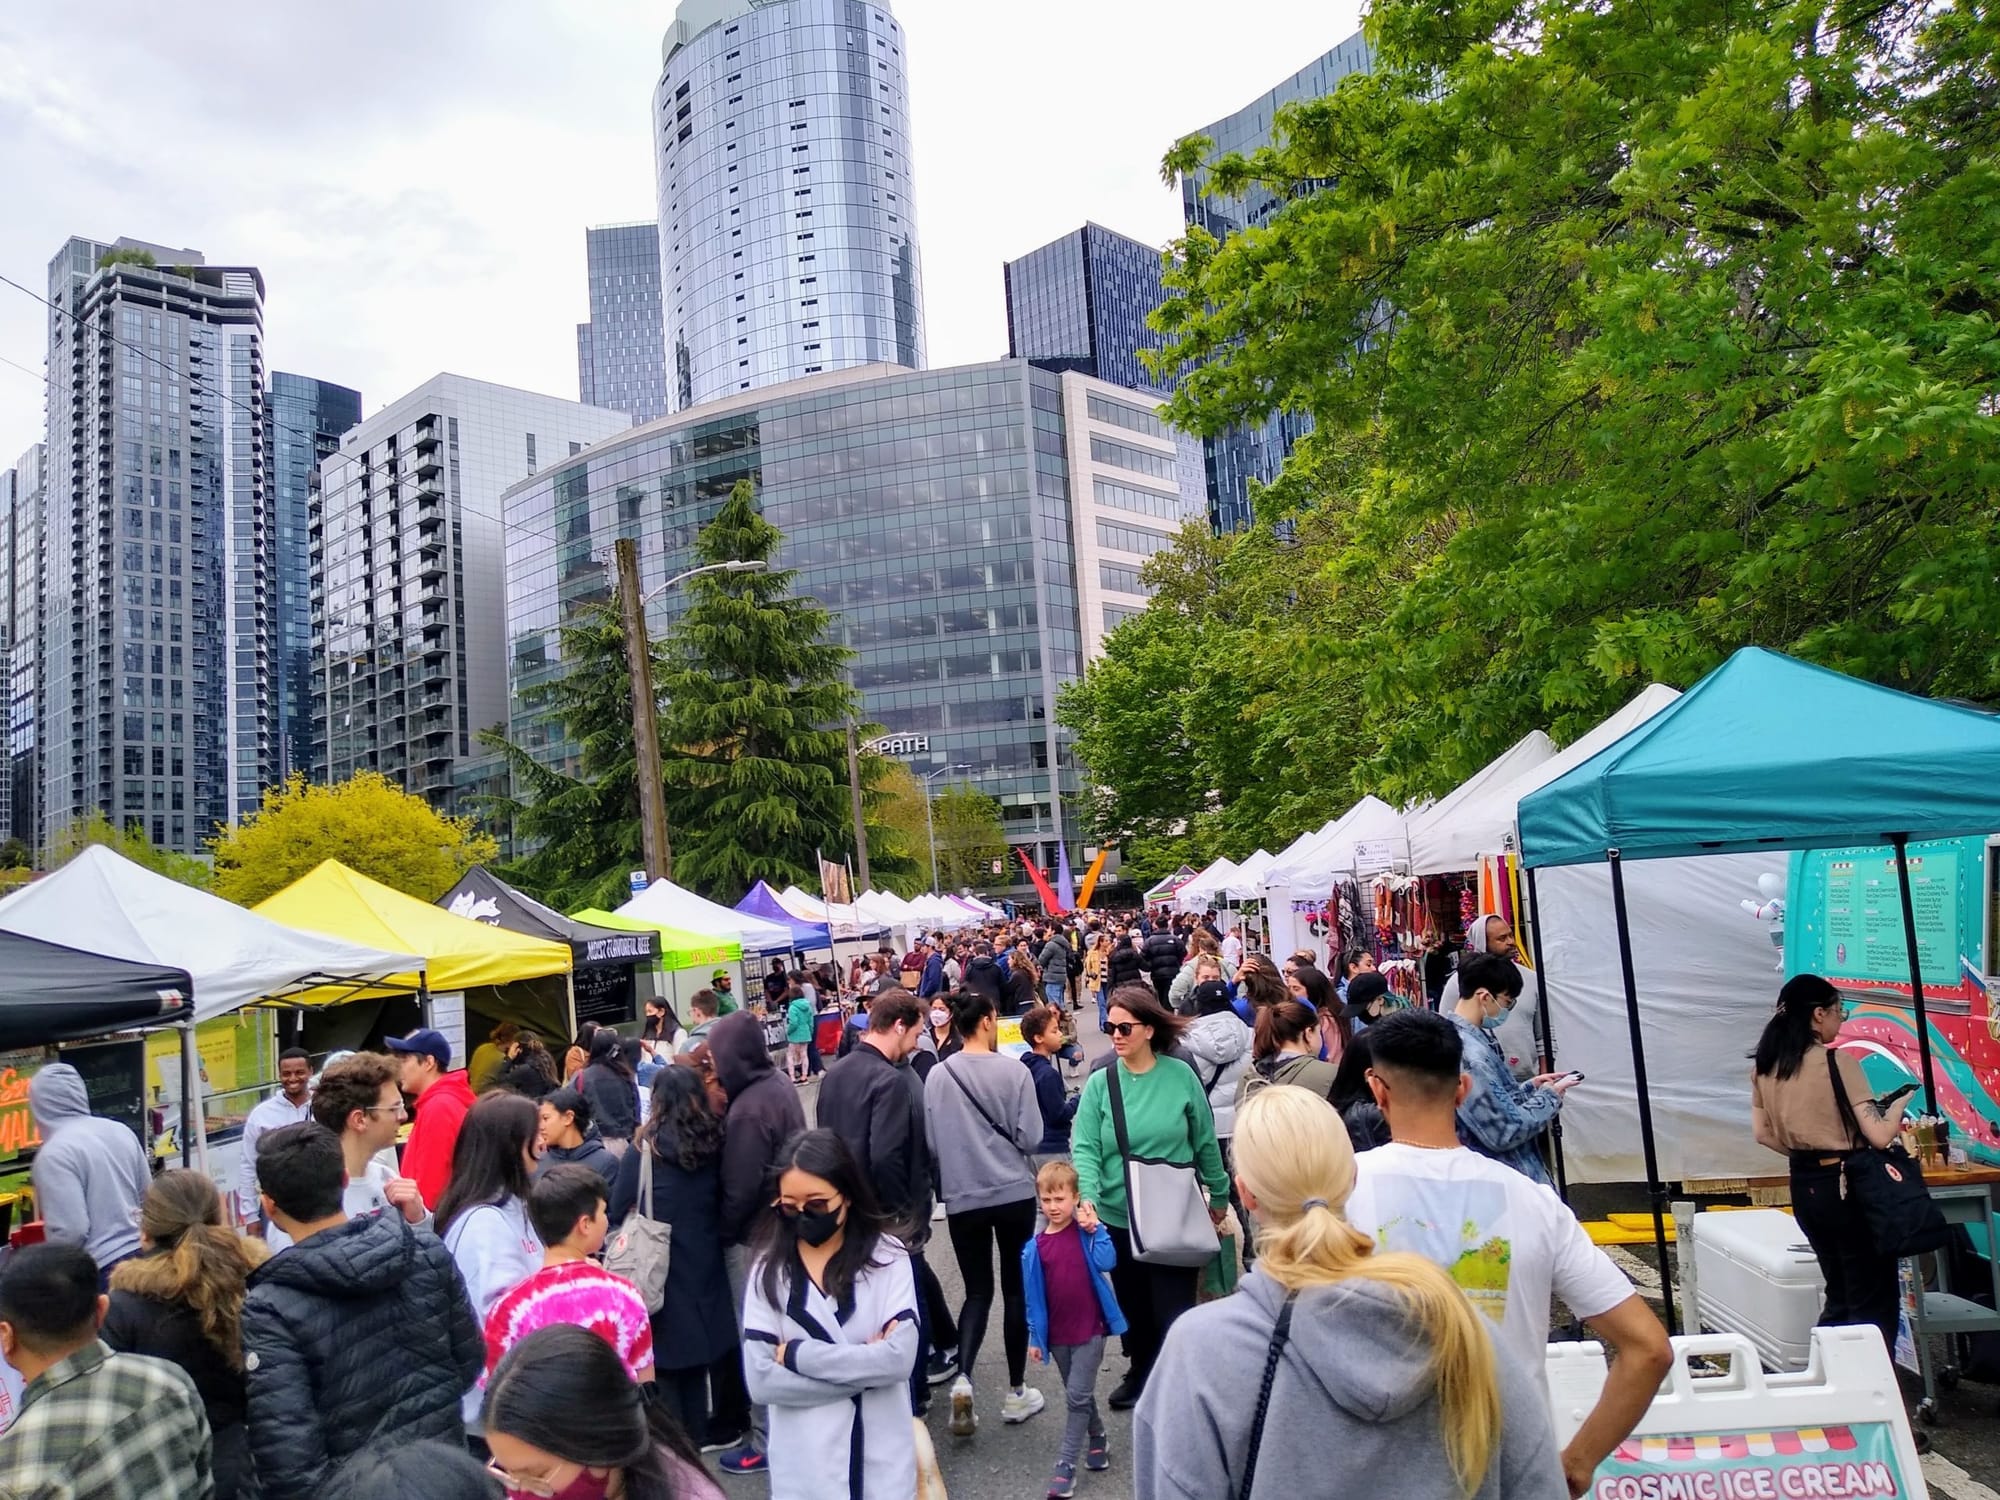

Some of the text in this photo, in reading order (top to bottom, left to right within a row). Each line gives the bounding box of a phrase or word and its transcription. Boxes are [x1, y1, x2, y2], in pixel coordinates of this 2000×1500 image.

[879, 736, 929, 755] PATH
[1099, 872, 1118, 883] elm
[1598, 1462, 1896, 1500] COSMIC ICE CREAM
